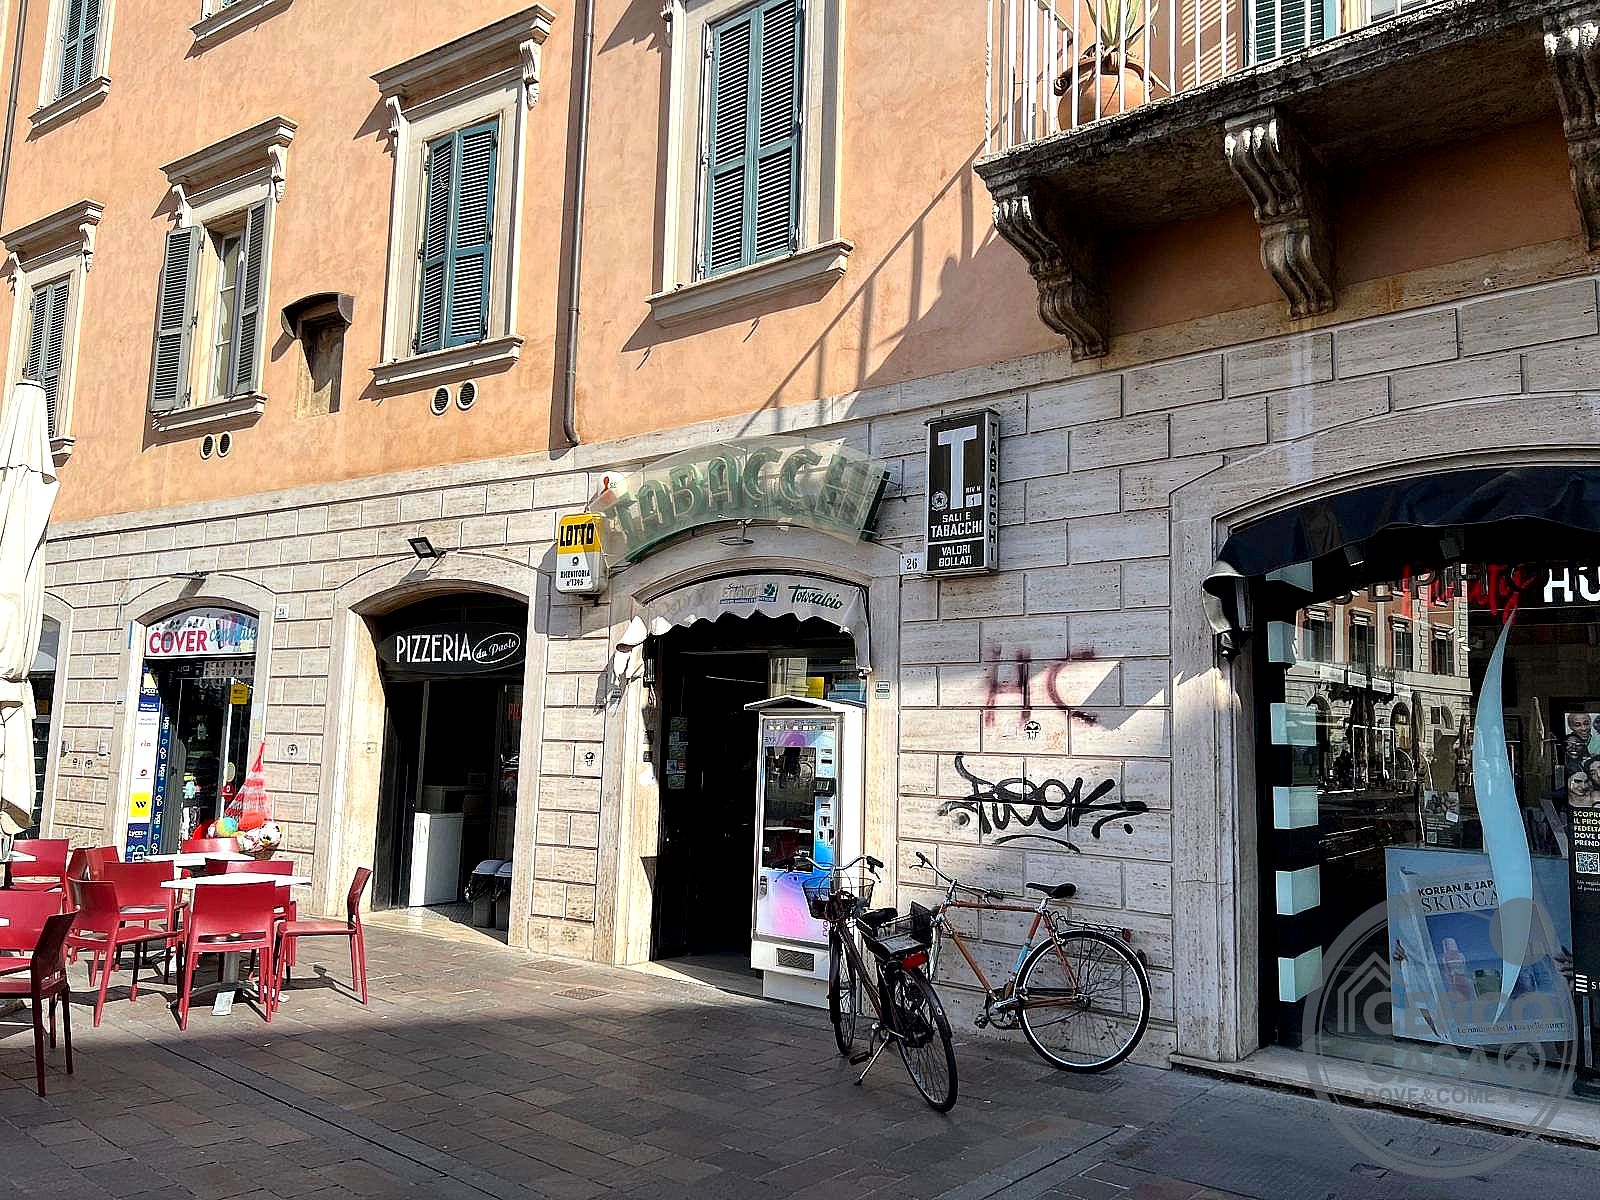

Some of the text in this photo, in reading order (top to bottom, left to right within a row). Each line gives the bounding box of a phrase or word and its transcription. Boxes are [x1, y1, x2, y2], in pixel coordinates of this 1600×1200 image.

[937, 424, 978, 510] T
[988, 422, 998, 561] TABACCHI
[942, 511, 971, 523] SALI E
[560, 523, 595, 547] LOTTO
[930, 519, 983, 538] TABACCHI
[941, 544, 971, 556] VALORI
[906, 558, 918, 570] 26
[938, 555, 972, 567] BOLLATI
[788, 583, 844, 610] Totocalcio
[149, 630, 208, 654] COVER
[396, 632, 516, 663] PIZZERIA da Paolo
[1574, 832, 1596, 840] DOVE
[1418, 879, 1497, 897] KOREAN & JAP
